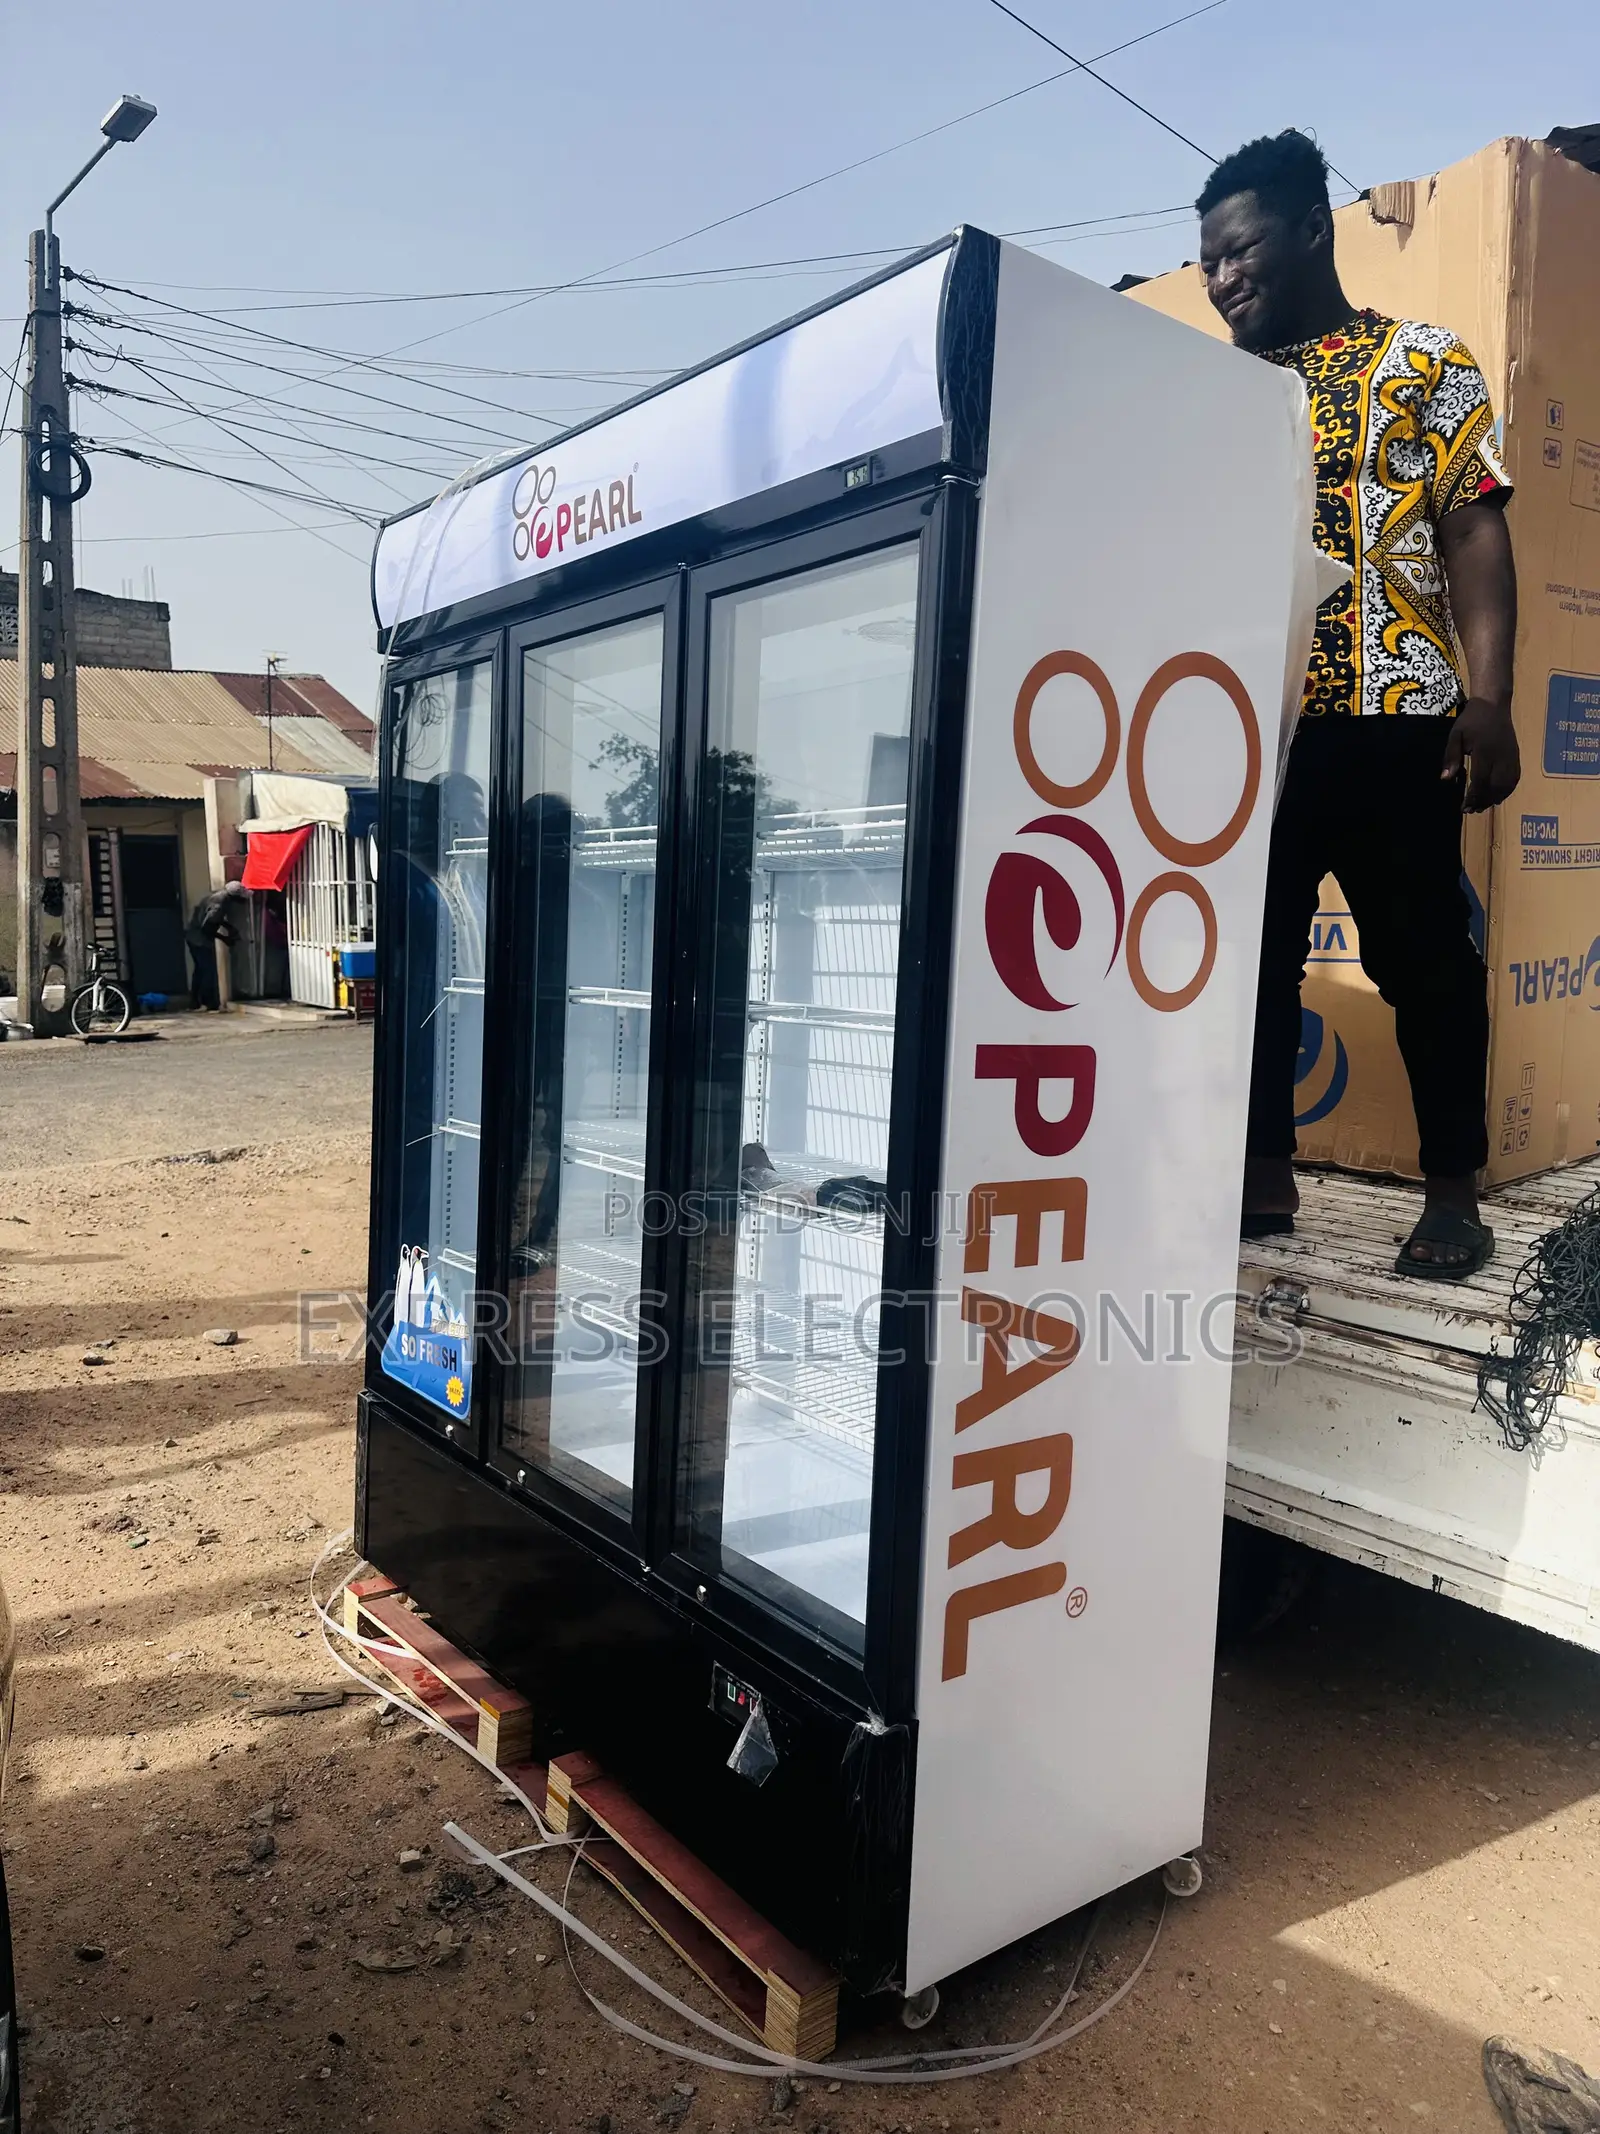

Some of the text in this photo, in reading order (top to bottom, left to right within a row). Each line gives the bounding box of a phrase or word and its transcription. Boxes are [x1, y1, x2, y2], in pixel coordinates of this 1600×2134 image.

[557, 474, 642, 552] PEARL
[1574, 692, 1590, 703] LIGHT
[1574, 736, 1599, 748] SHELVES
[1522, 821, 1557, 839] PVC-150
[1522, 848, 1600, 864] RIGHT SHOWCASE
[1313, 923, 1348, 950] VI
[1509, 954, 1584, 1007] PEARL
[401, 1333, 457, 1372] SO FRESH
[941, 1044, 1097, 1683] PEARL
